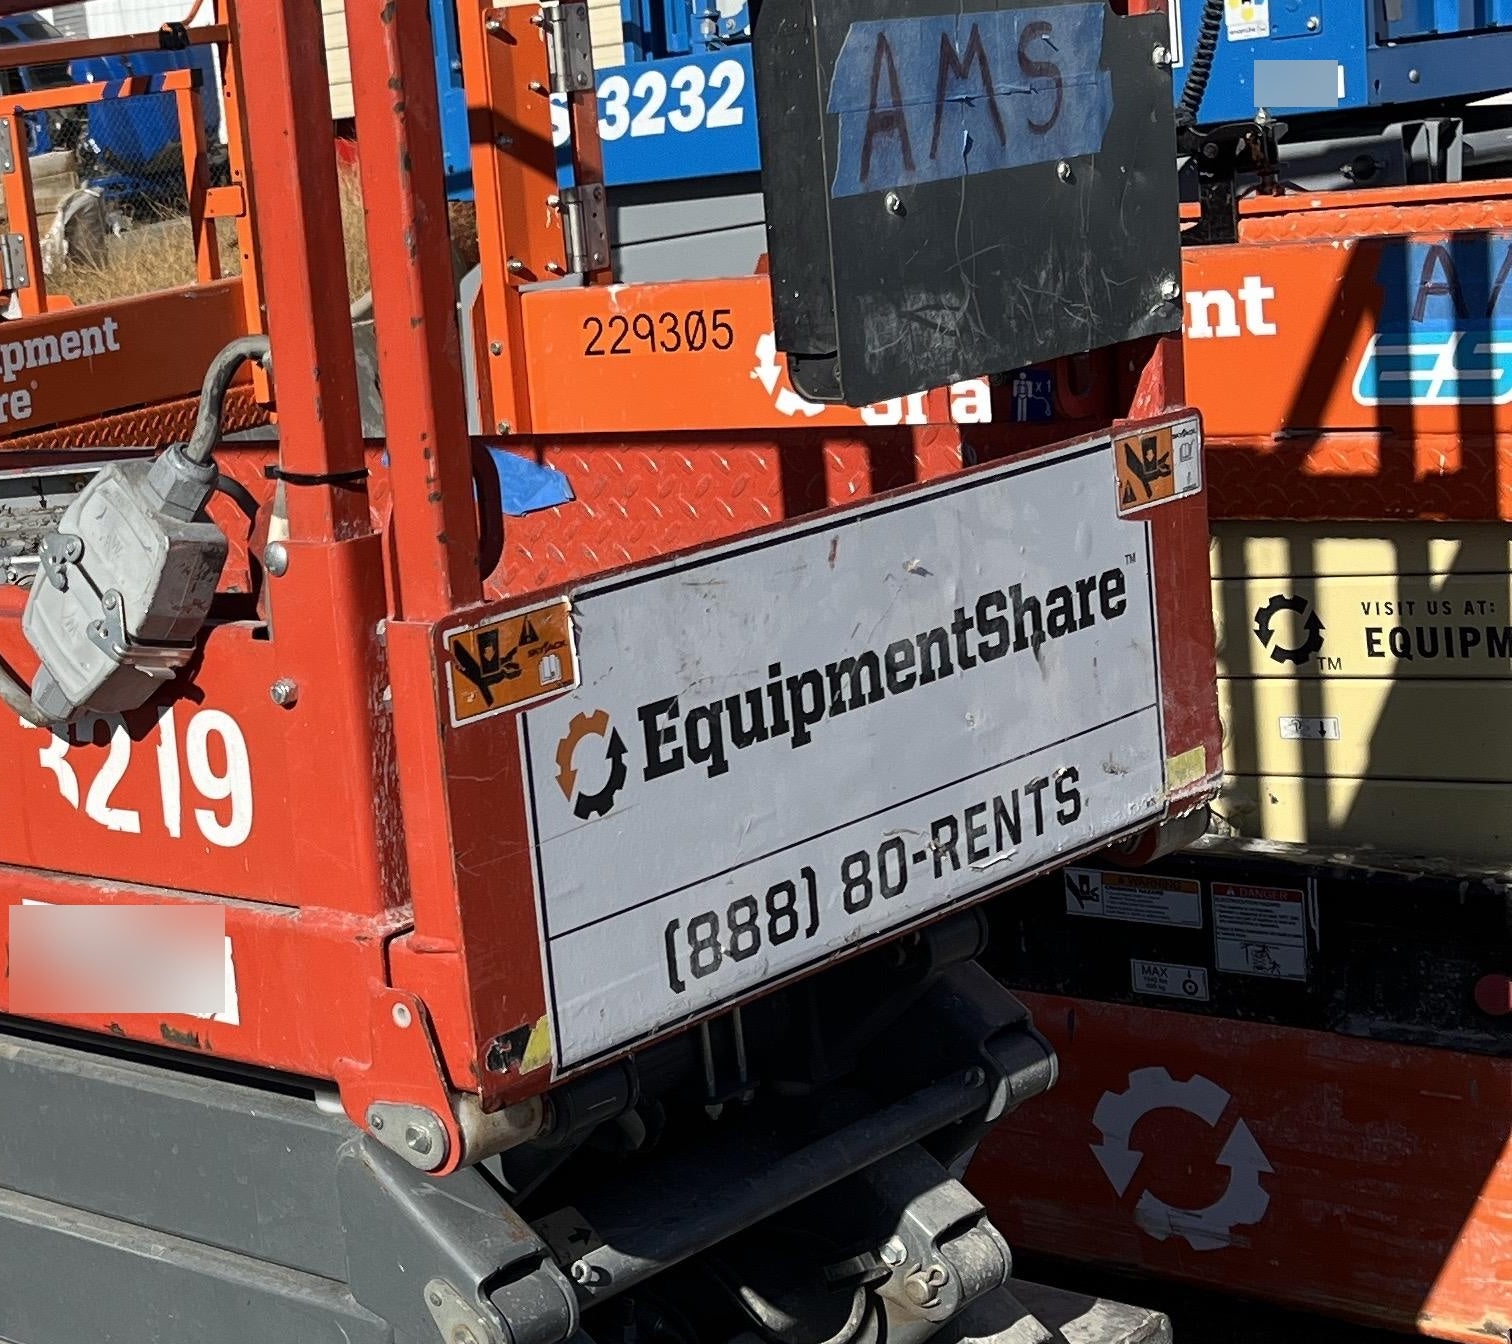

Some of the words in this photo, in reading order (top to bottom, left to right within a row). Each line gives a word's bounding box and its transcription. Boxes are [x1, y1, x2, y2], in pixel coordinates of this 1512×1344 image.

[596, 59, 746, 141] 3232
[858, 20, 1064, 184] AMS
[582, 309, 734, 356] 229305
[1360, 600, 1416, 617] VISIT
[1426, 600, 1453, 616] US
[1463, 599, 1496, 616] AT:
[637, 566, 1128, 782] EquipmentShare
[664, 864, 820, 995] (888)
[840, 765, 1083, 916] 80-RENTS
[1239, 887, 1289, 900] DANGER
[1141, 964, 1168, 978] MAX
